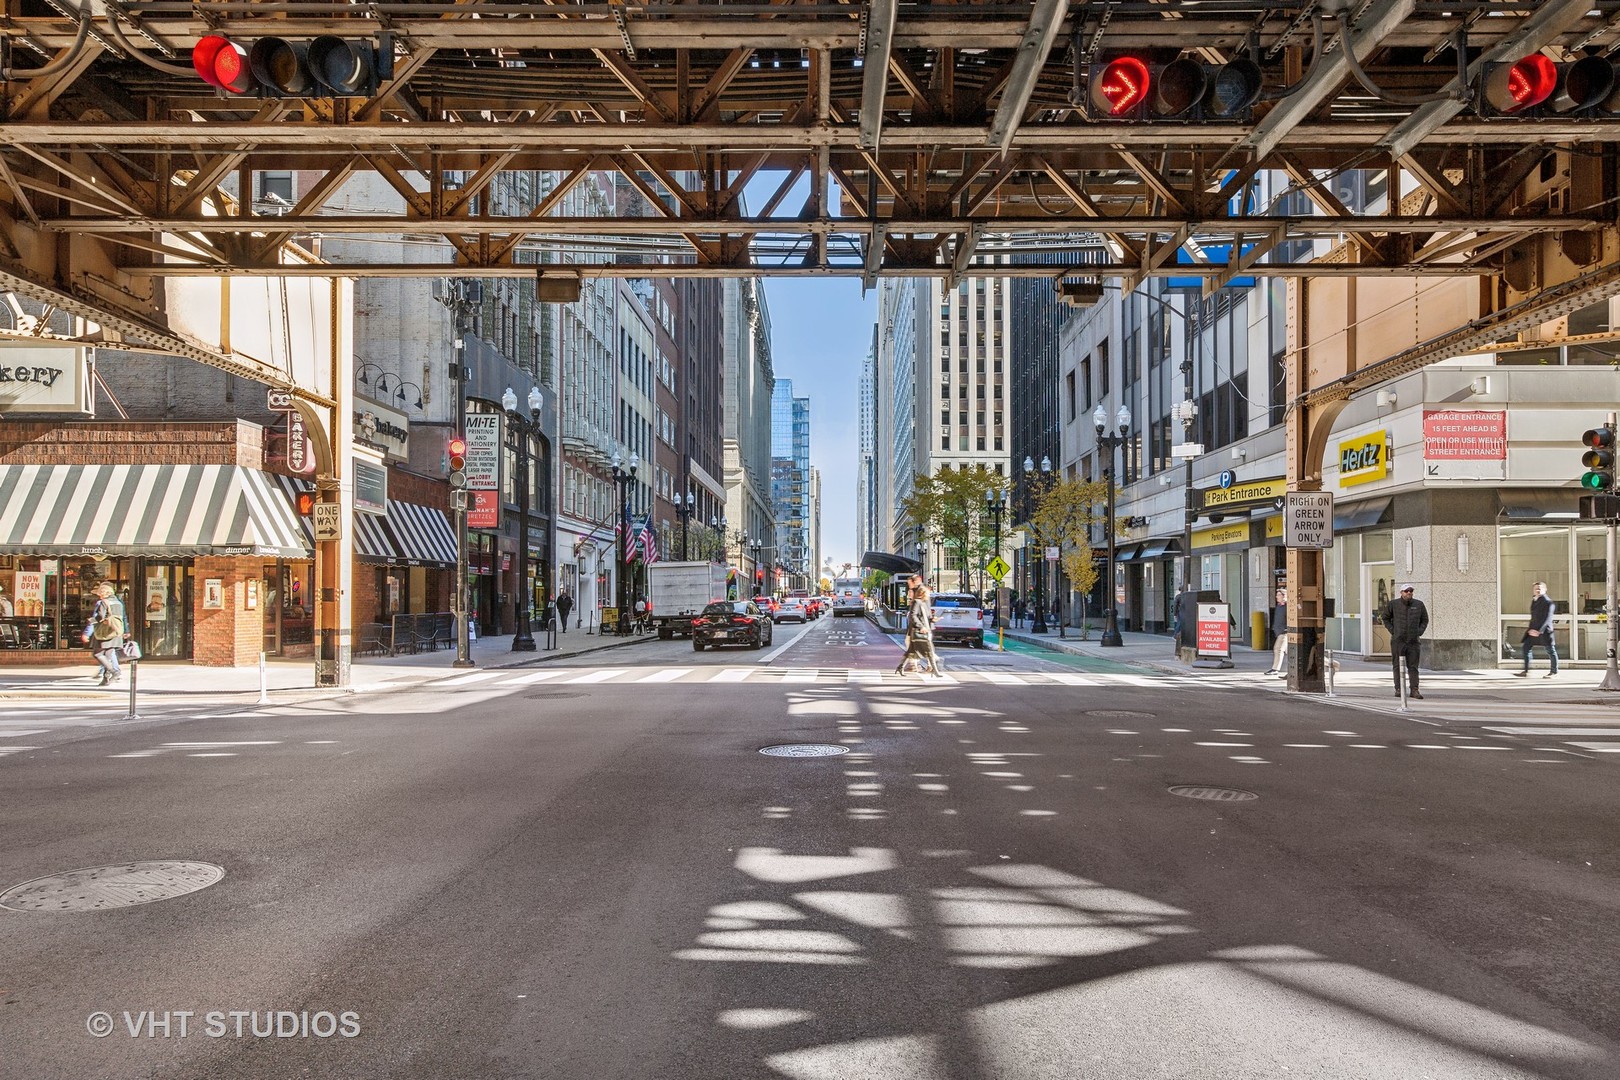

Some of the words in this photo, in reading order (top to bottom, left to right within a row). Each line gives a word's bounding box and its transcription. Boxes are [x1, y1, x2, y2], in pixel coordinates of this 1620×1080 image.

[375, 417, 409, 444] bakery
[292, 412, 304, 468] BAKERY
[1341, 443, 1381, 472] Hertz
[1211, 493, 1229, 504] Park
[1230, 486, 1272, 501] Entrance
[1290, 497, 1314, 506] RIGHT
[1318, 497, 1329, 506] ON
[317, 506, 338, 515] ONE
[1295, 509, 1324, 518] GREEN
[317, 516, 338, 526] WAY
[1294, 521, 1325, 530] ARROW
[1211, 533, 1224, 541] Parking
[1225, 530, 1242, 539] Elevators
[1298, 533, 1321, 542] ONLY
